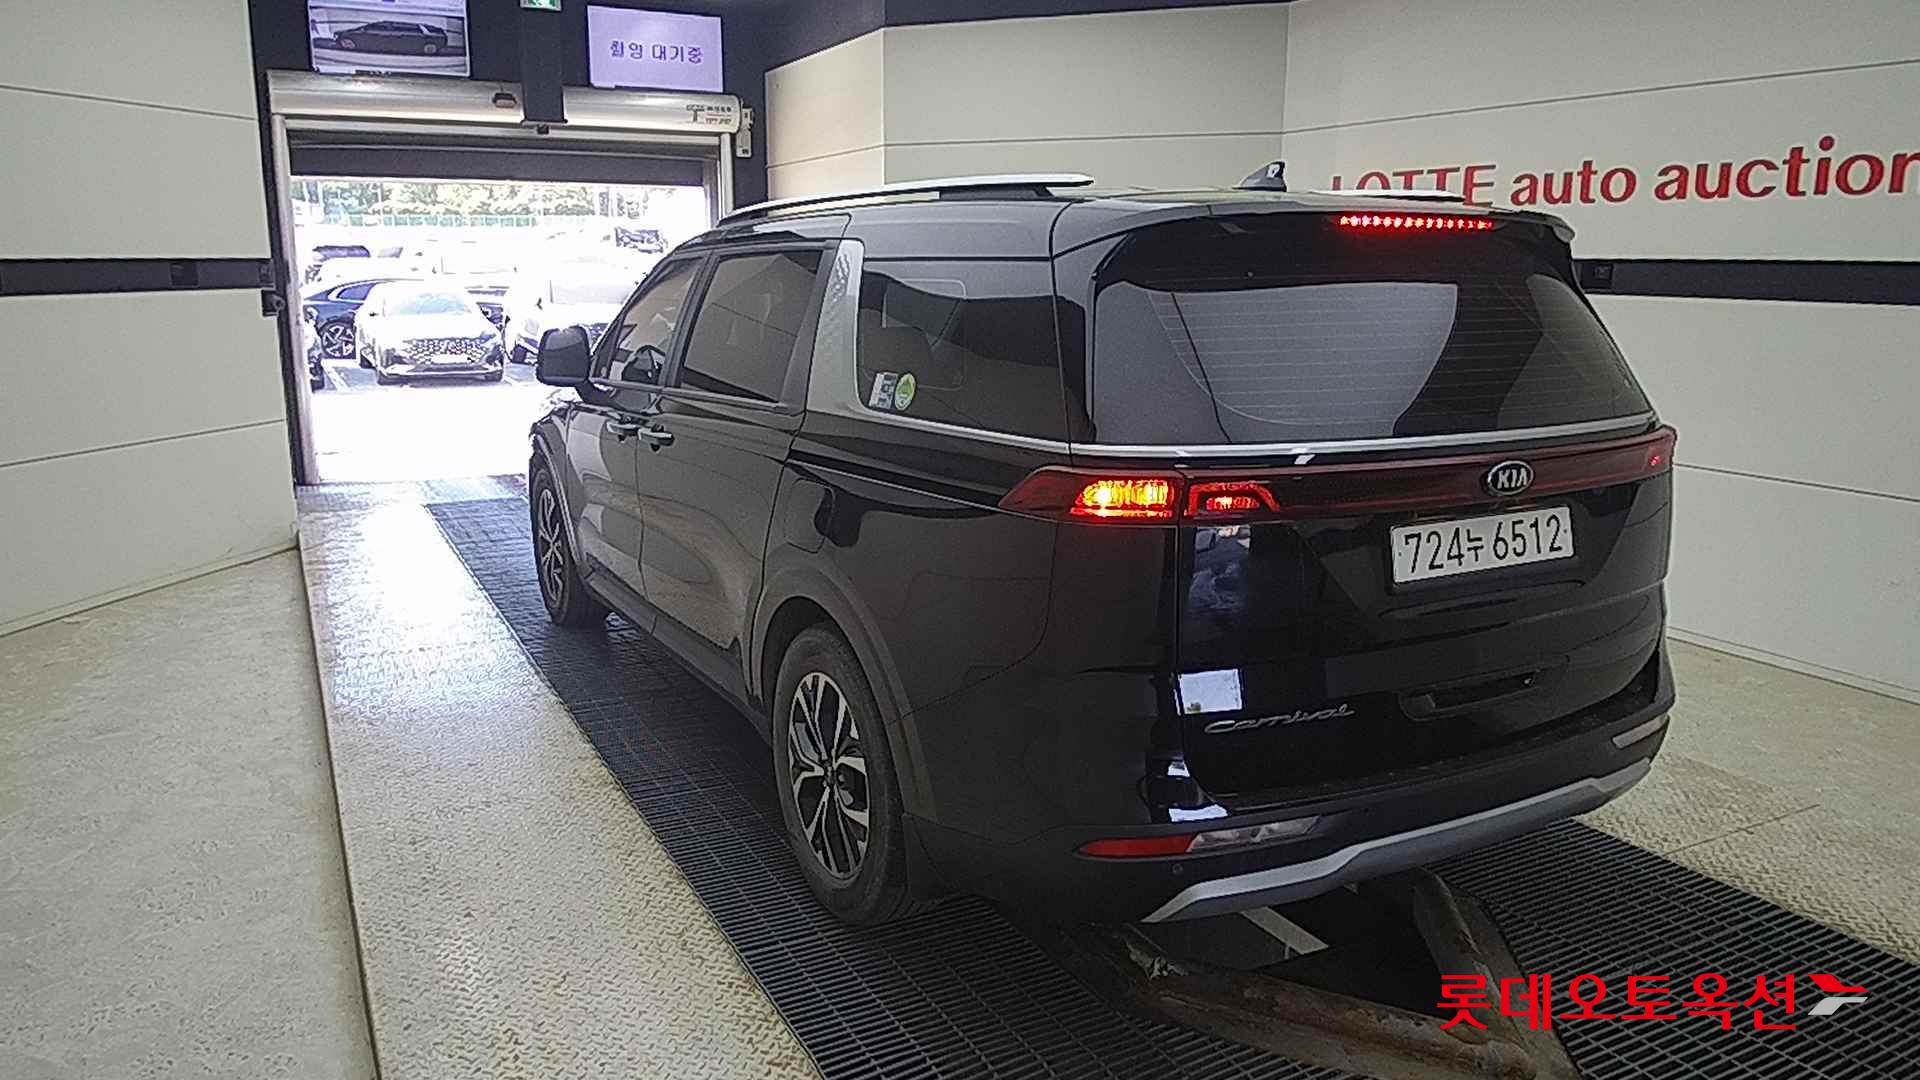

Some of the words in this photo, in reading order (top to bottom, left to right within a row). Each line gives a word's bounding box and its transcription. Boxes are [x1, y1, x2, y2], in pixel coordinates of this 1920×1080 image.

[652, 44, 702, 65] 대기중
[1510, 160, 1638, 206] auto
[1496, 467, 1529, 490] KIA
[1404, 527, 1485, 574] 724누
[1493, 514, 1563, 561] 6512
[1205, 703, 1356, 734] Carnival
